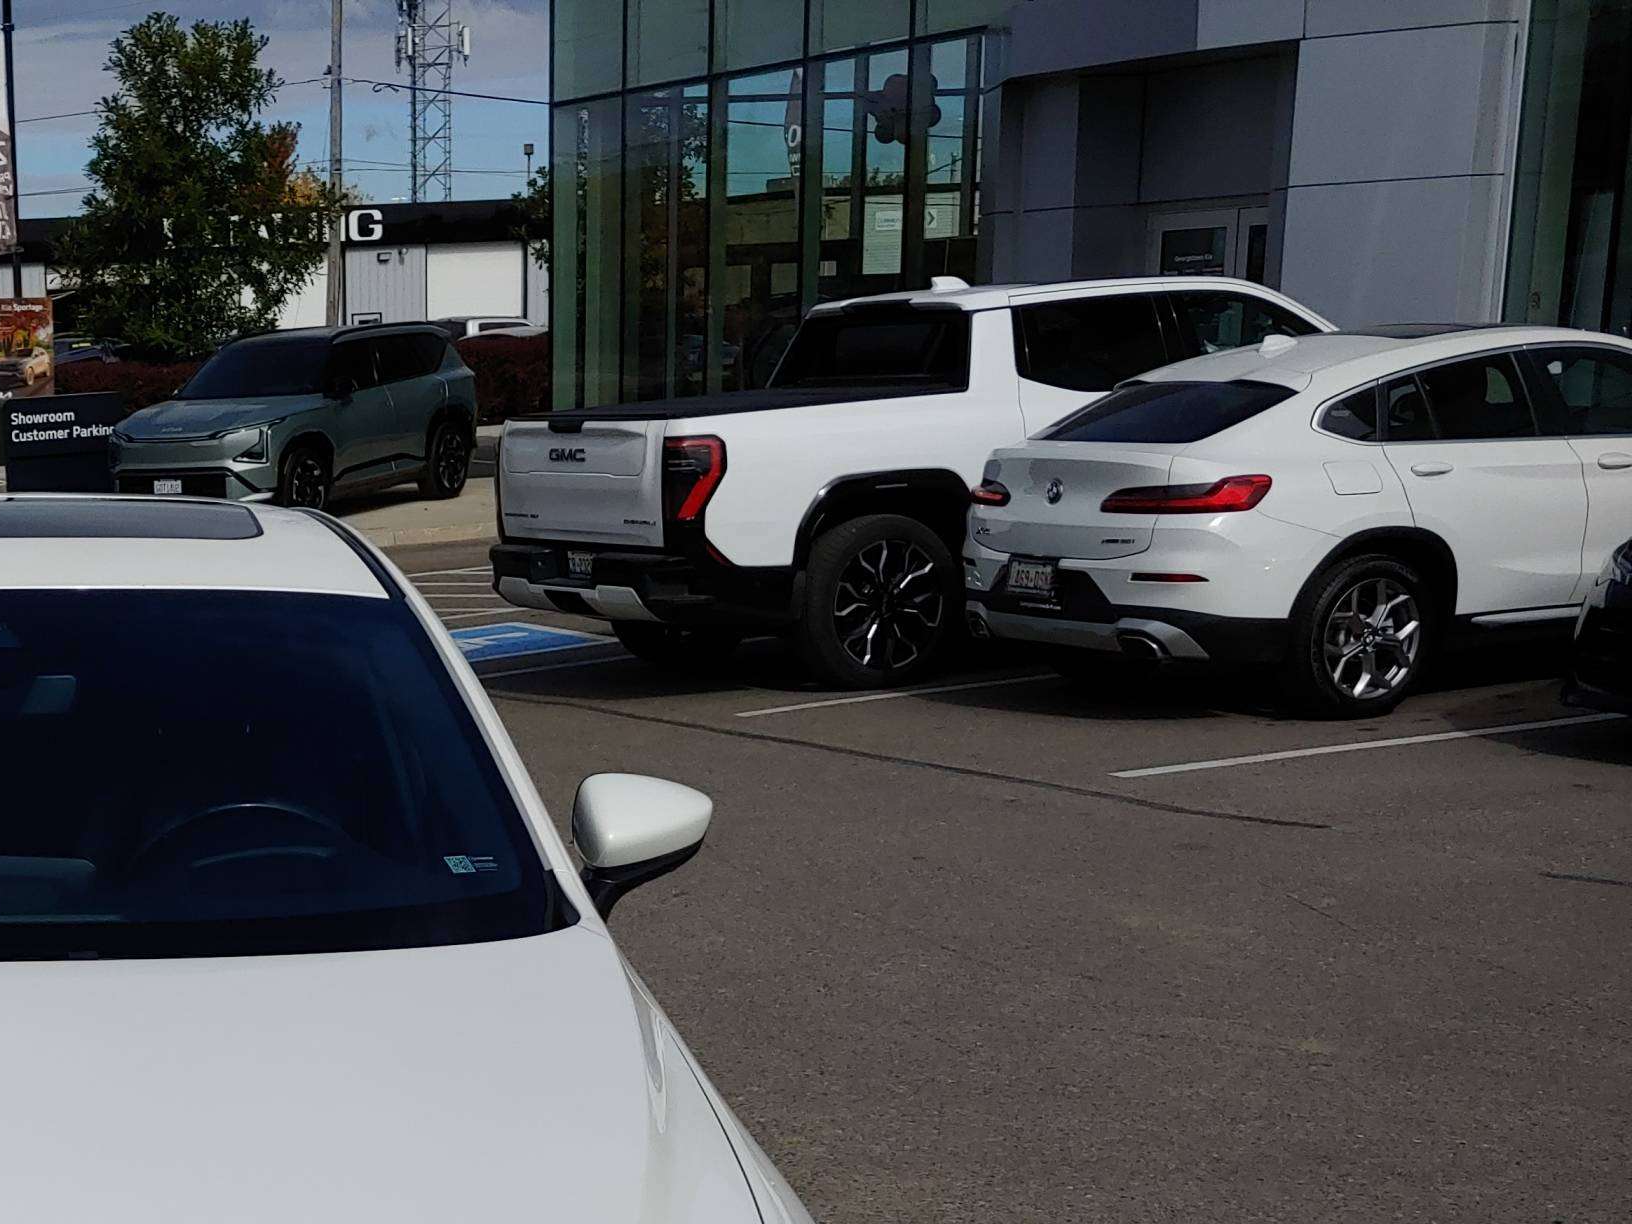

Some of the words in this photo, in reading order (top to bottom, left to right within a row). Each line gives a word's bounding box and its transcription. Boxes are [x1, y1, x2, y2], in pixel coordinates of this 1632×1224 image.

[10, 411, 76, 426] Showroom
[11, 427, 71, 442] Customer
[549, 448, 586, 462] GMC
